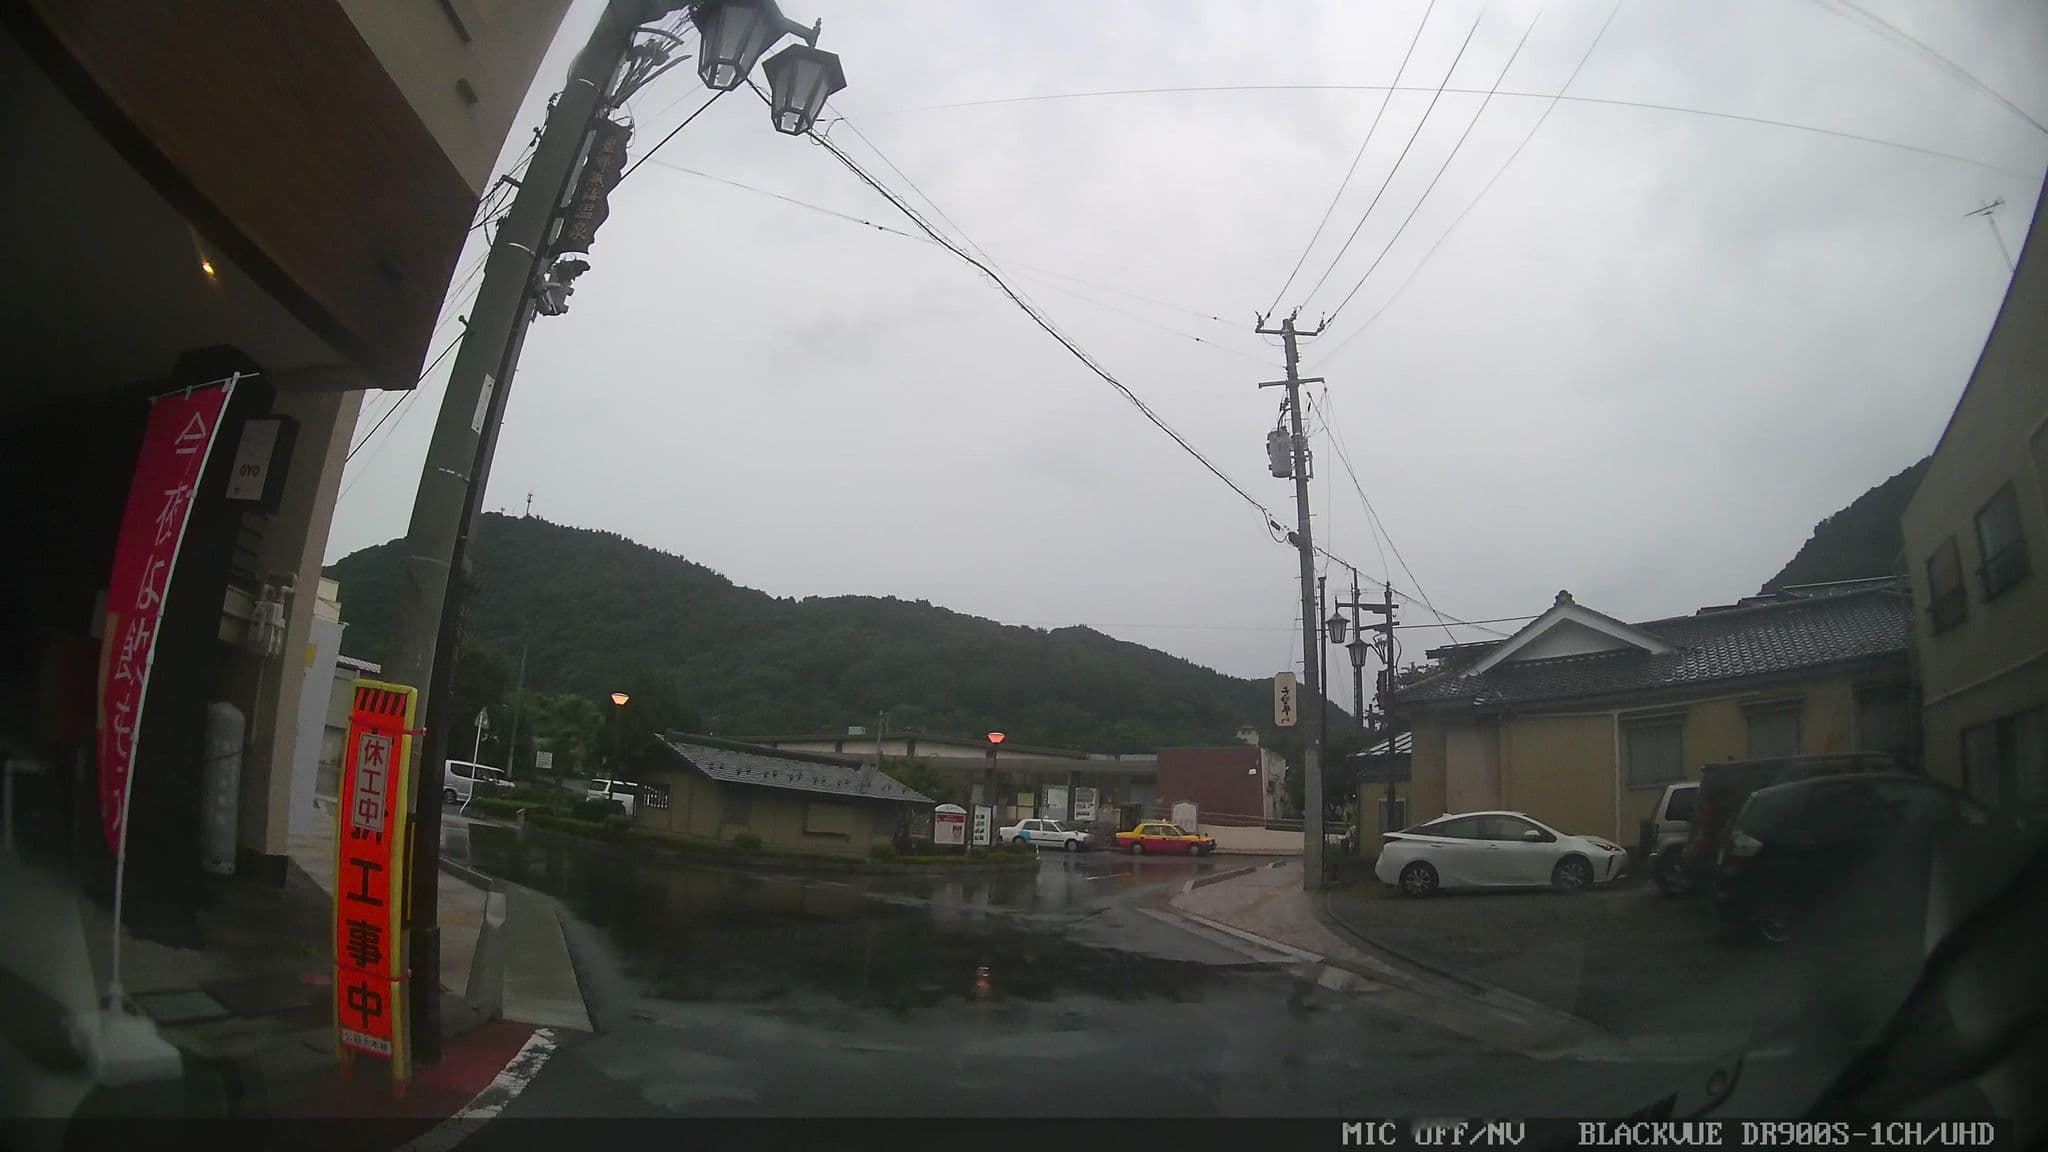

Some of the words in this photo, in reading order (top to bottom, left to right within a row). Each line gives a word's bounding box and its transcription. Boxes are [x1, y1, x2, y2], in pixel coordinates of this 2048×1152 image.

[239, 463, 261, 478] OYO
[358, 738, 386, 825] 休工中
